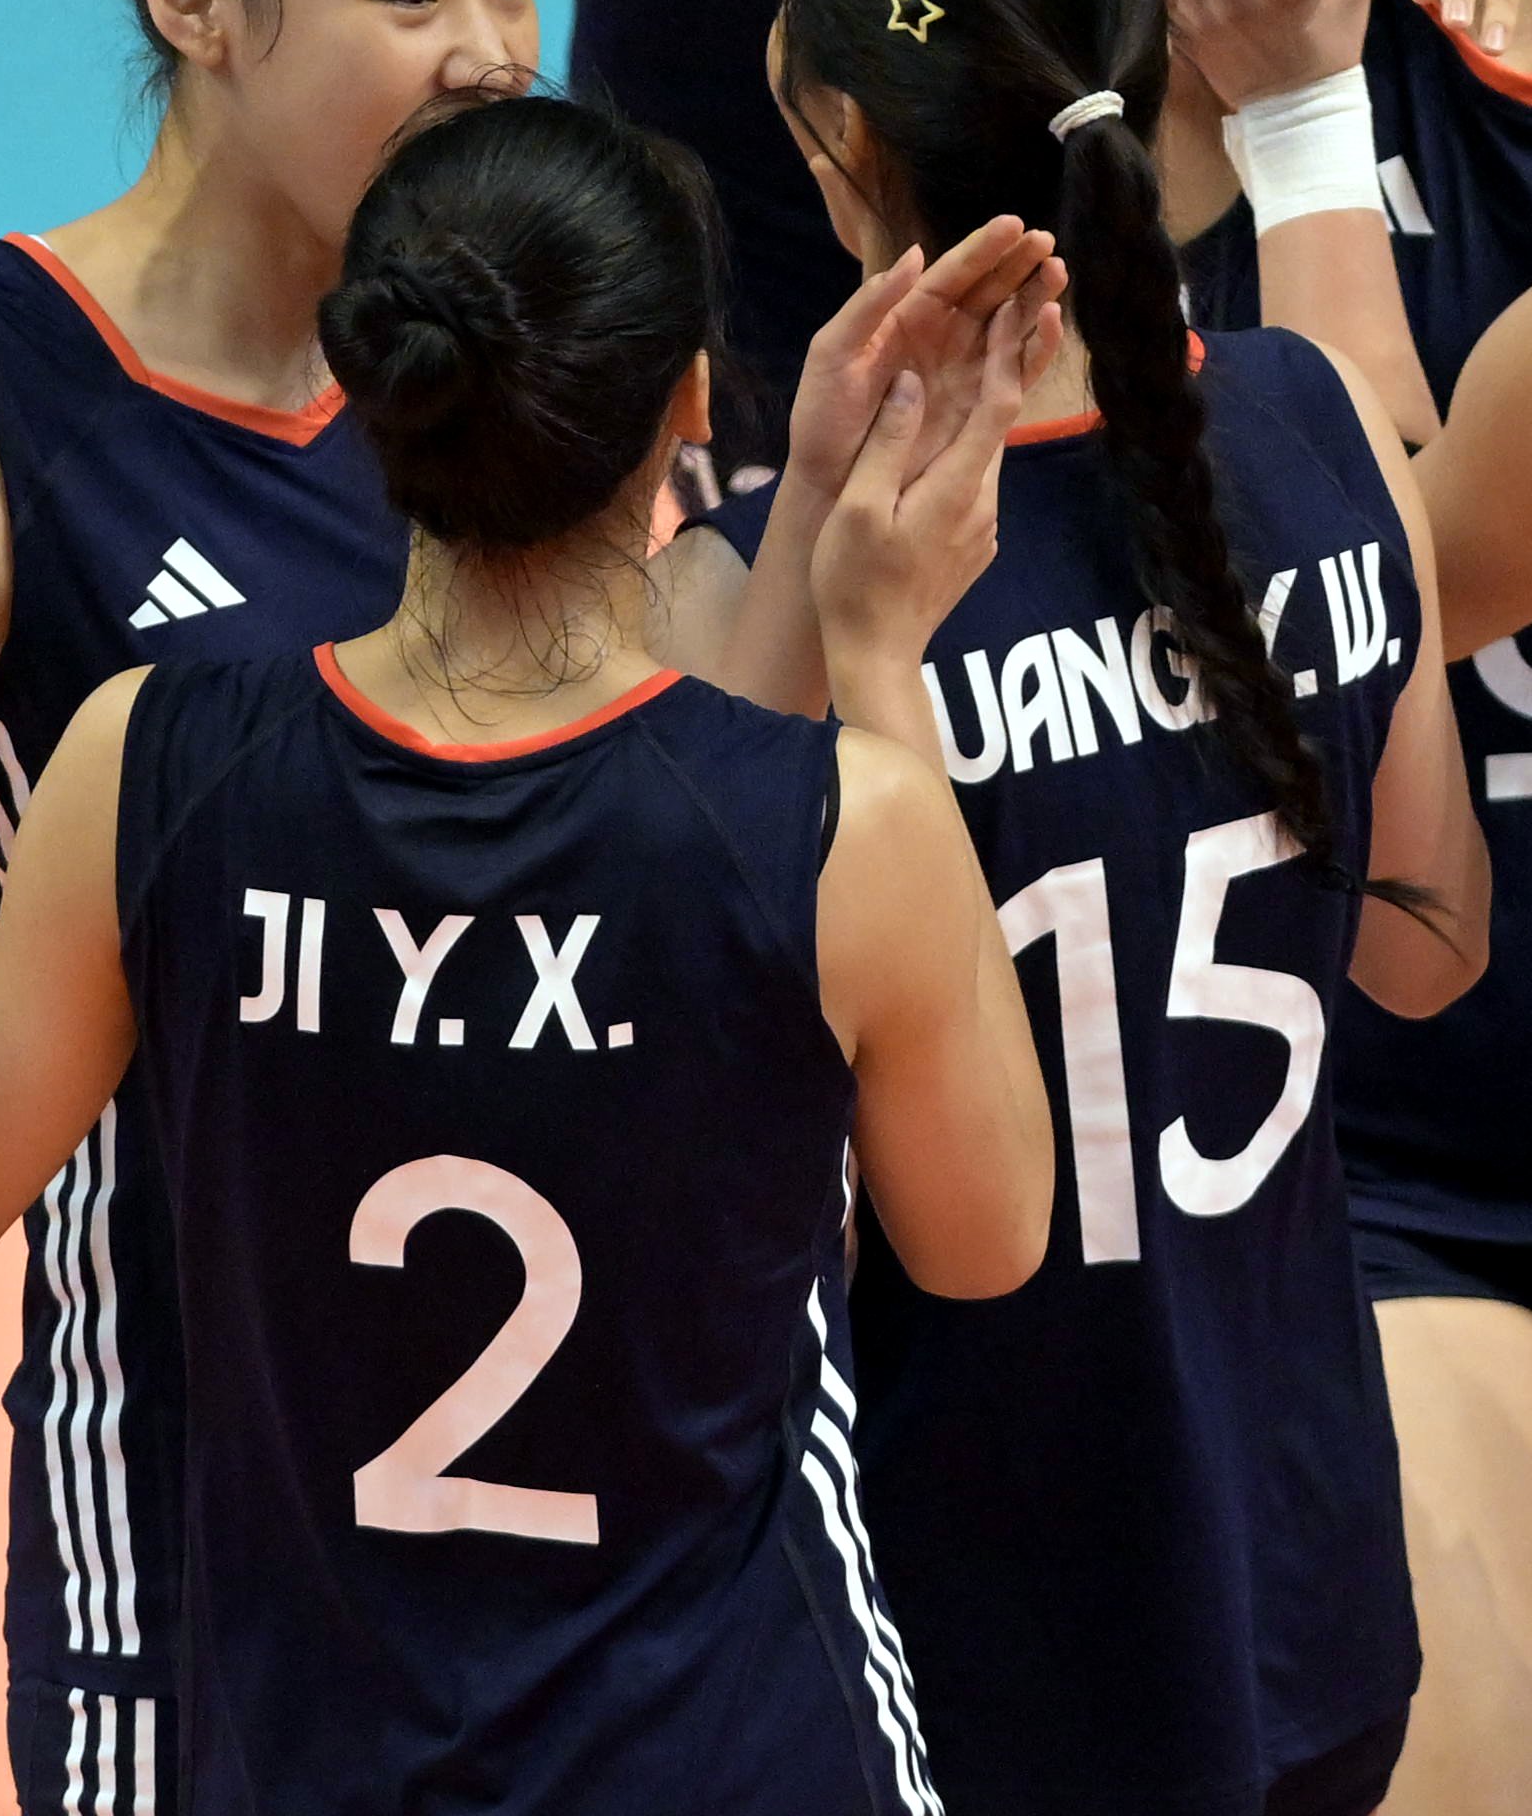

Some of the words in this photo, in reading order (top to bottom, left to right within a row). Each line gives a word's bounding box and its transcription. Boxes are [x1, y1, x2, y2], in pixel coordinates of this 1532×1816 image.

[238, 887, 326, 1034] JI
[995, 809, 1326, 1266] 15
[348, 1154, 600, 1545] 2
